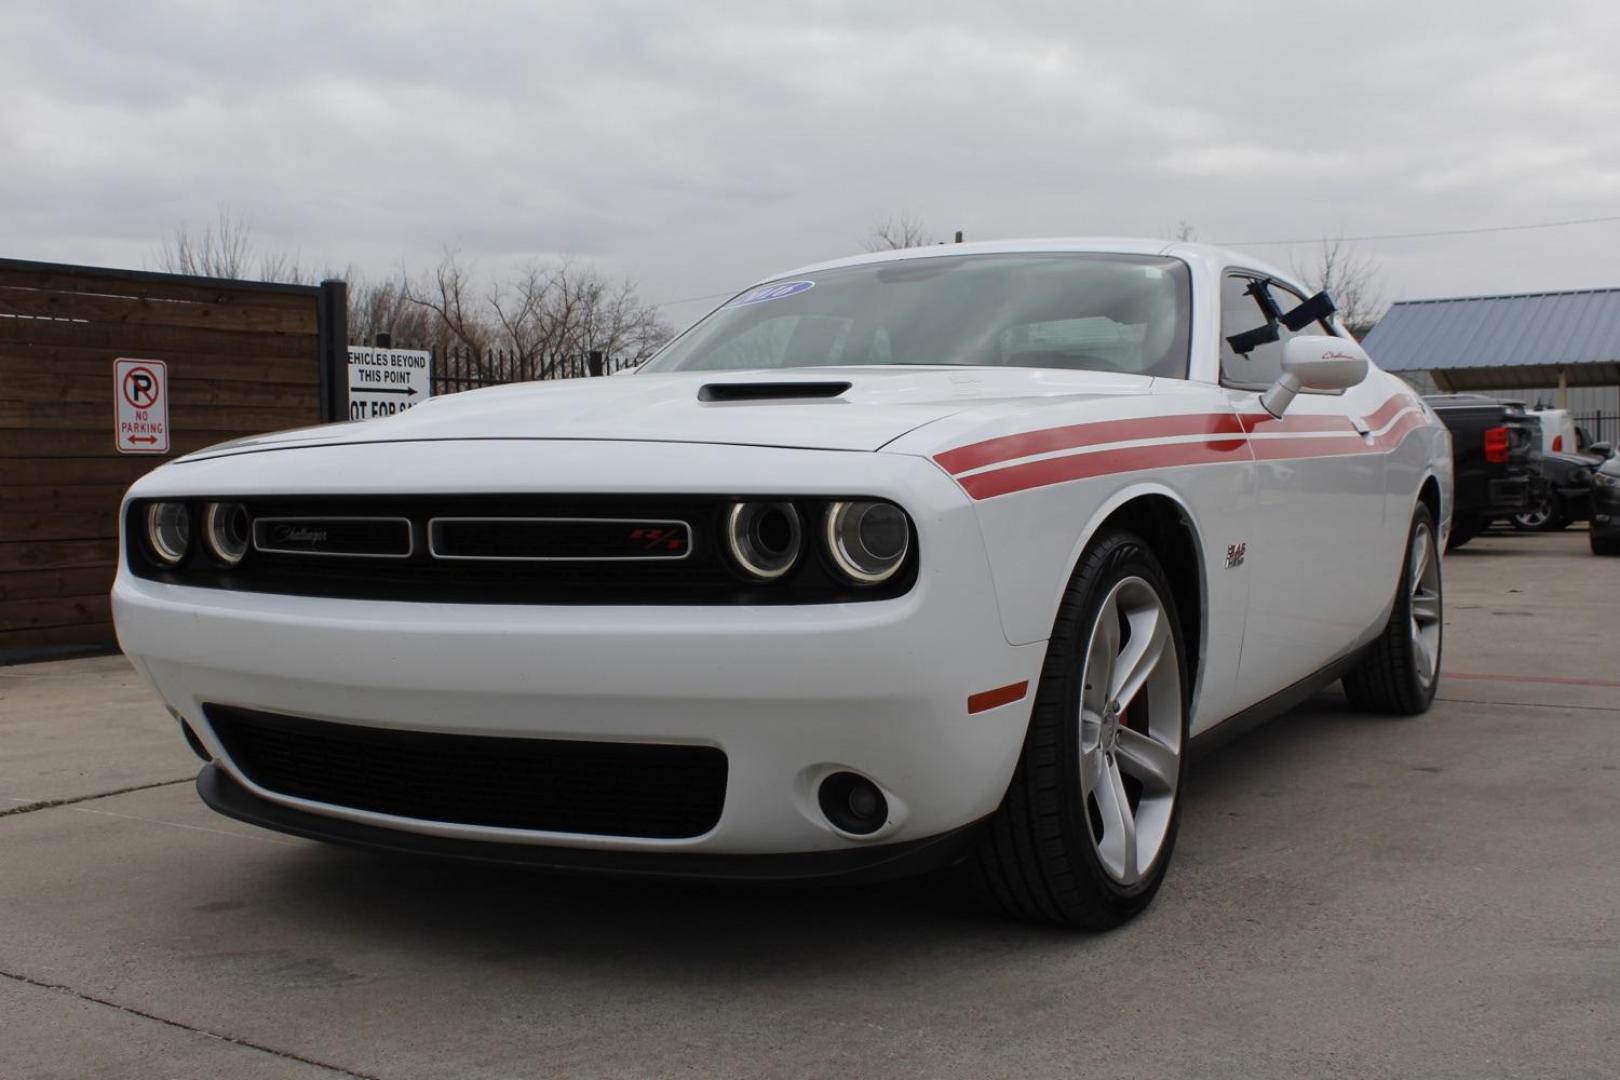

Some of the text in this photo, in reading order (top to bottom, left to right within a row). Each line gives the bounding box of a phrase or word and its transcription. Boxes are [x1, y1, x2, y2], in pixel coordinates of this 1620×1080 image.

[347, 352, 426, 369] EHICLES BEYOND
[358, 369, 412, 384] THIS POINT
[135, 411, 148, 422] NO
[350, 400, 368, 421] OT
[121, 422, 163, 434] PARKING
